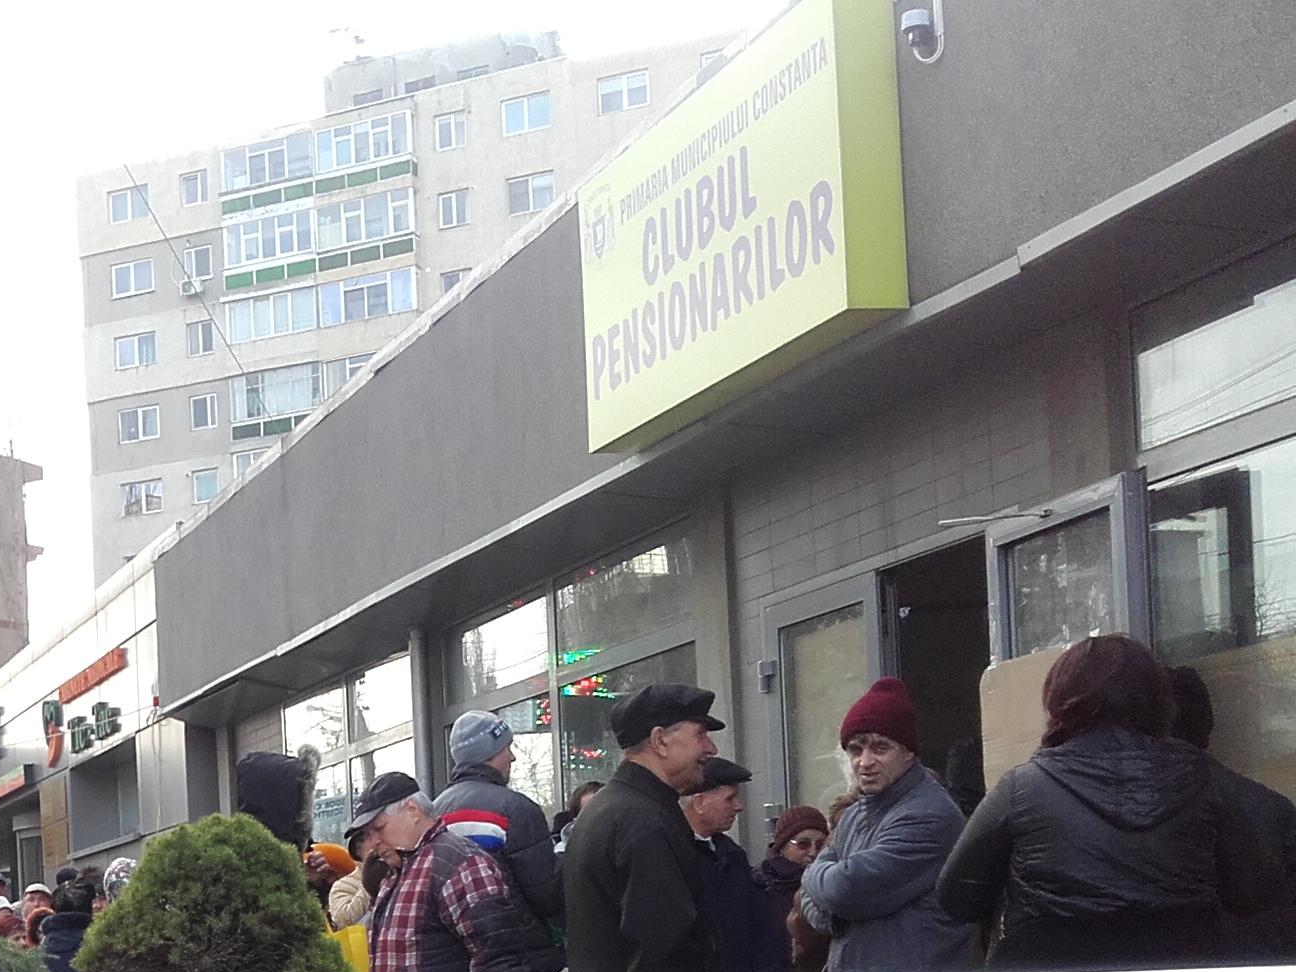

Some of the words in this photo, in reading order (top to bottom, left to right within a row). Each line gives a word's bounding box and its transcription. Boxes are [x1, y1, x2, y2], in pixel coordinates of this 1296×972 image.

[619, 165, 669, 226] PRIMARIA
[671, 99, 750, 186] MUNICIPIULUI
[752, 36, 829, 122] CONSTANTA
[642, 145, 757, 286] CLUBUL
[592, 180, 835, 401] PENSIONARILOR
